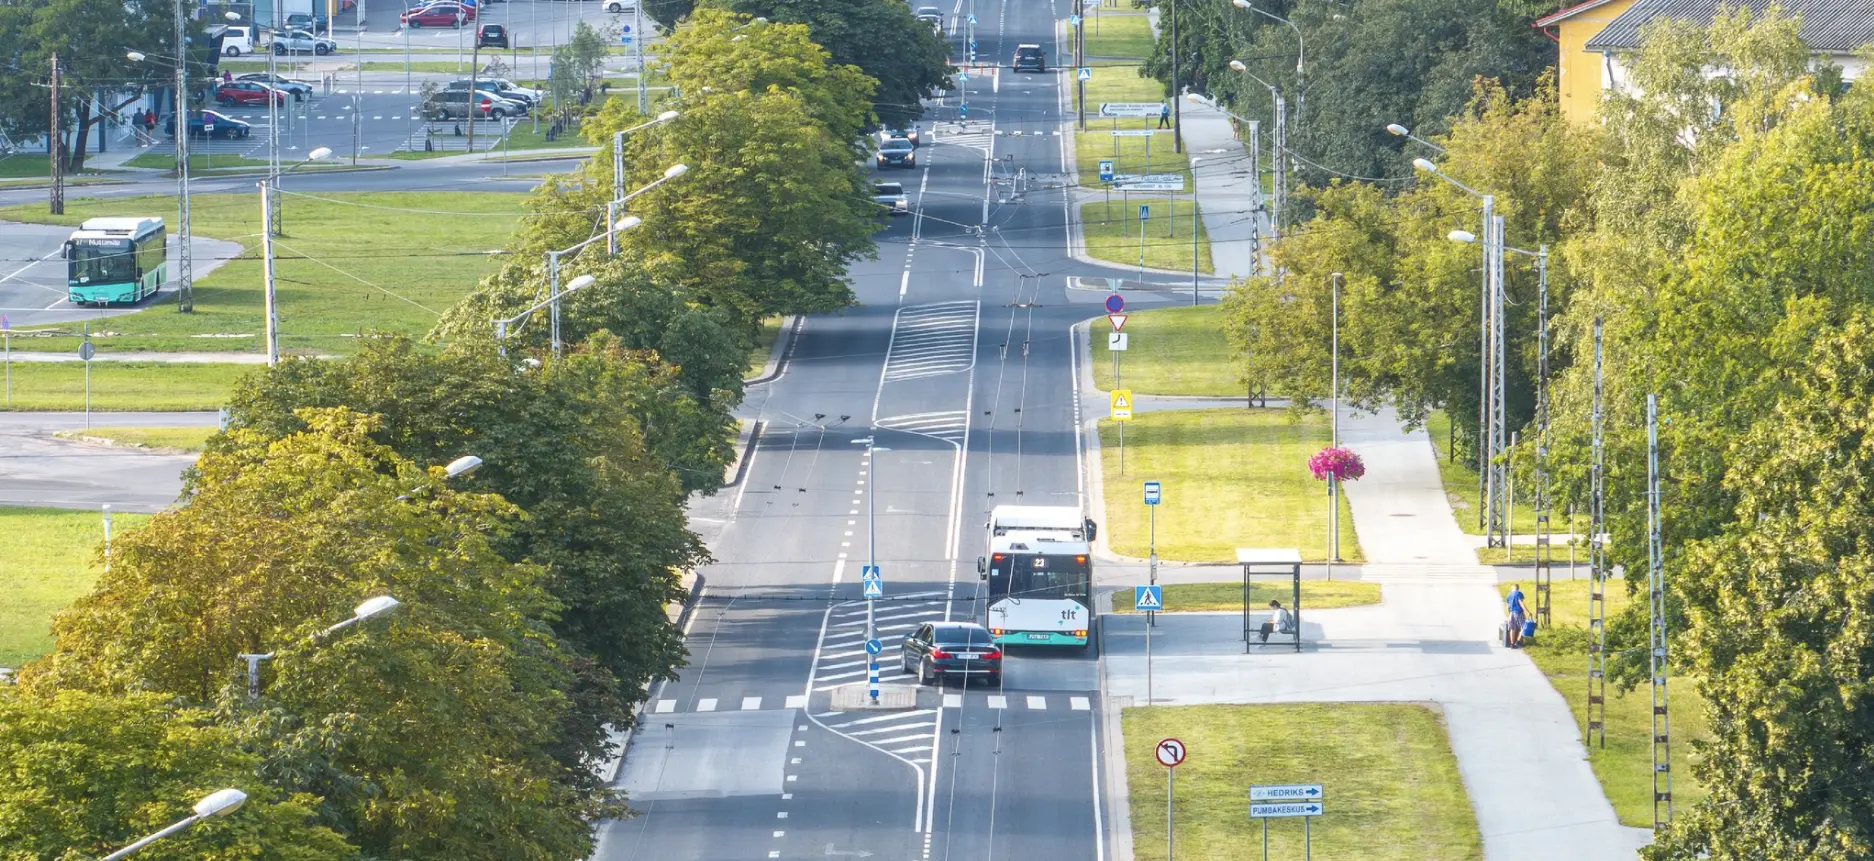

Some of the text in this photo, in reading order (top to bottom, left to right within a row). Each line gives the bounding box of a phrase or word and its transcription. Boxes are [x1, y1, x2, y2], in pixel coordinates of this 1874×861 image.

[1034, 558, 1044, 567] 23
[1060, 608, 1076, 620] tlt
[1268, 788, 1304, 796] HEDRIKS
[1252, 806, 1305, 814] PUMBAKESKUS
